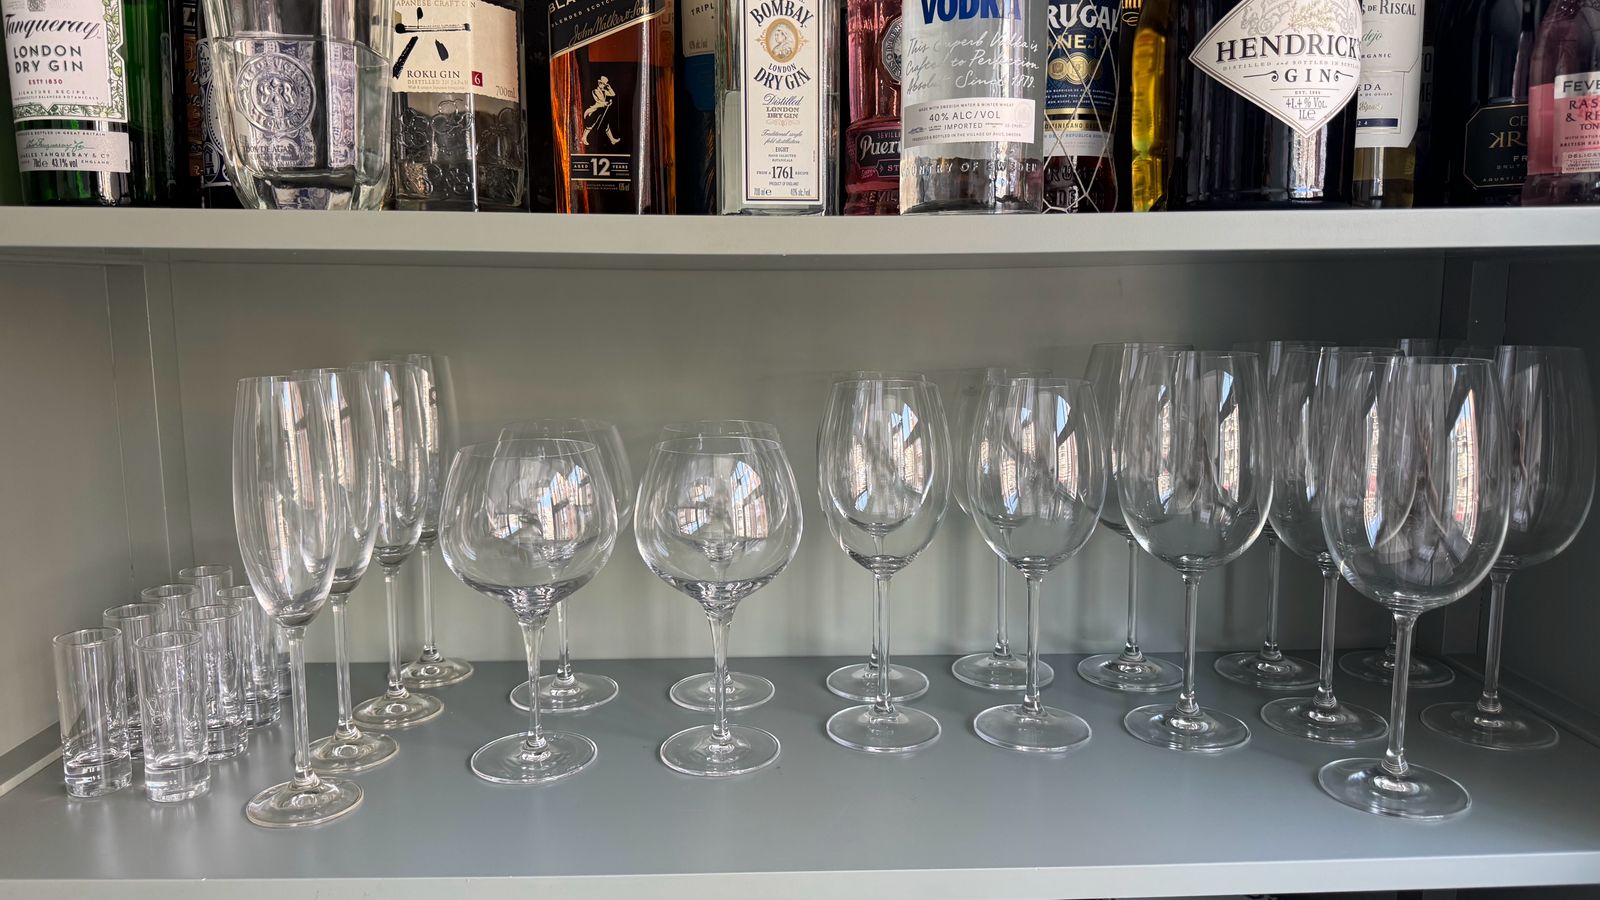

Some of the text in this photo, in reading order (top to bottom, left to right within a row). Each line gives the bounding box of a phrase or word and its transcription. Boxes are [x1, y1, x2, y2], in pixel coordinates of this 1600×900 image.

[750, 0, 814, 28] BOMBAY
[920, 0, 1022, 25] VODKA
[1379, 0, 1417, 16] RISCAL
[551, 10, 582, 28] BLENDED
[5, 14, 101, 40] Tanqueray
[568, 22, 594, 48] John
[593, 10, 626, 33] Walker
[906, 38, 928, 57] This
[934, 30, 989, 53] Sperb
[1030, 41, 1038, 52] is
[1048, 32, 1105, 49] AÑEJ
[14, 45, 82, 60] LONDON
[15, 60, 84, 74] DRY GIN
[768, 62, 797, 74] LONDON
[905, 50, 1040, 76] Crafte to Perfection
[1222, 62, 1272, 72] DISTILLED
[406, 70, 460, 78] ROKU GIN
[754, 66, 812, 90] DRY GIN
[1284, 68, 1331, 83] GIN
[906, 75, 950, 95] Absolu
[955, 70, 1004, 90] Since
[496, 85, 518, 99] 700ml
[762, 93, 804, 106] Distilled
[1569, 99, 1599, 110] RAS
[929, 110, 1001, 122] 40% ALC/VOL
[1565, 113, 1576, 122] &
[944, 122, 983, 130] IMPORTED
[69, 159, 78, 168] vol
[590, 158, 610, 176] 12
[772, 166, 794, 179] 1761
